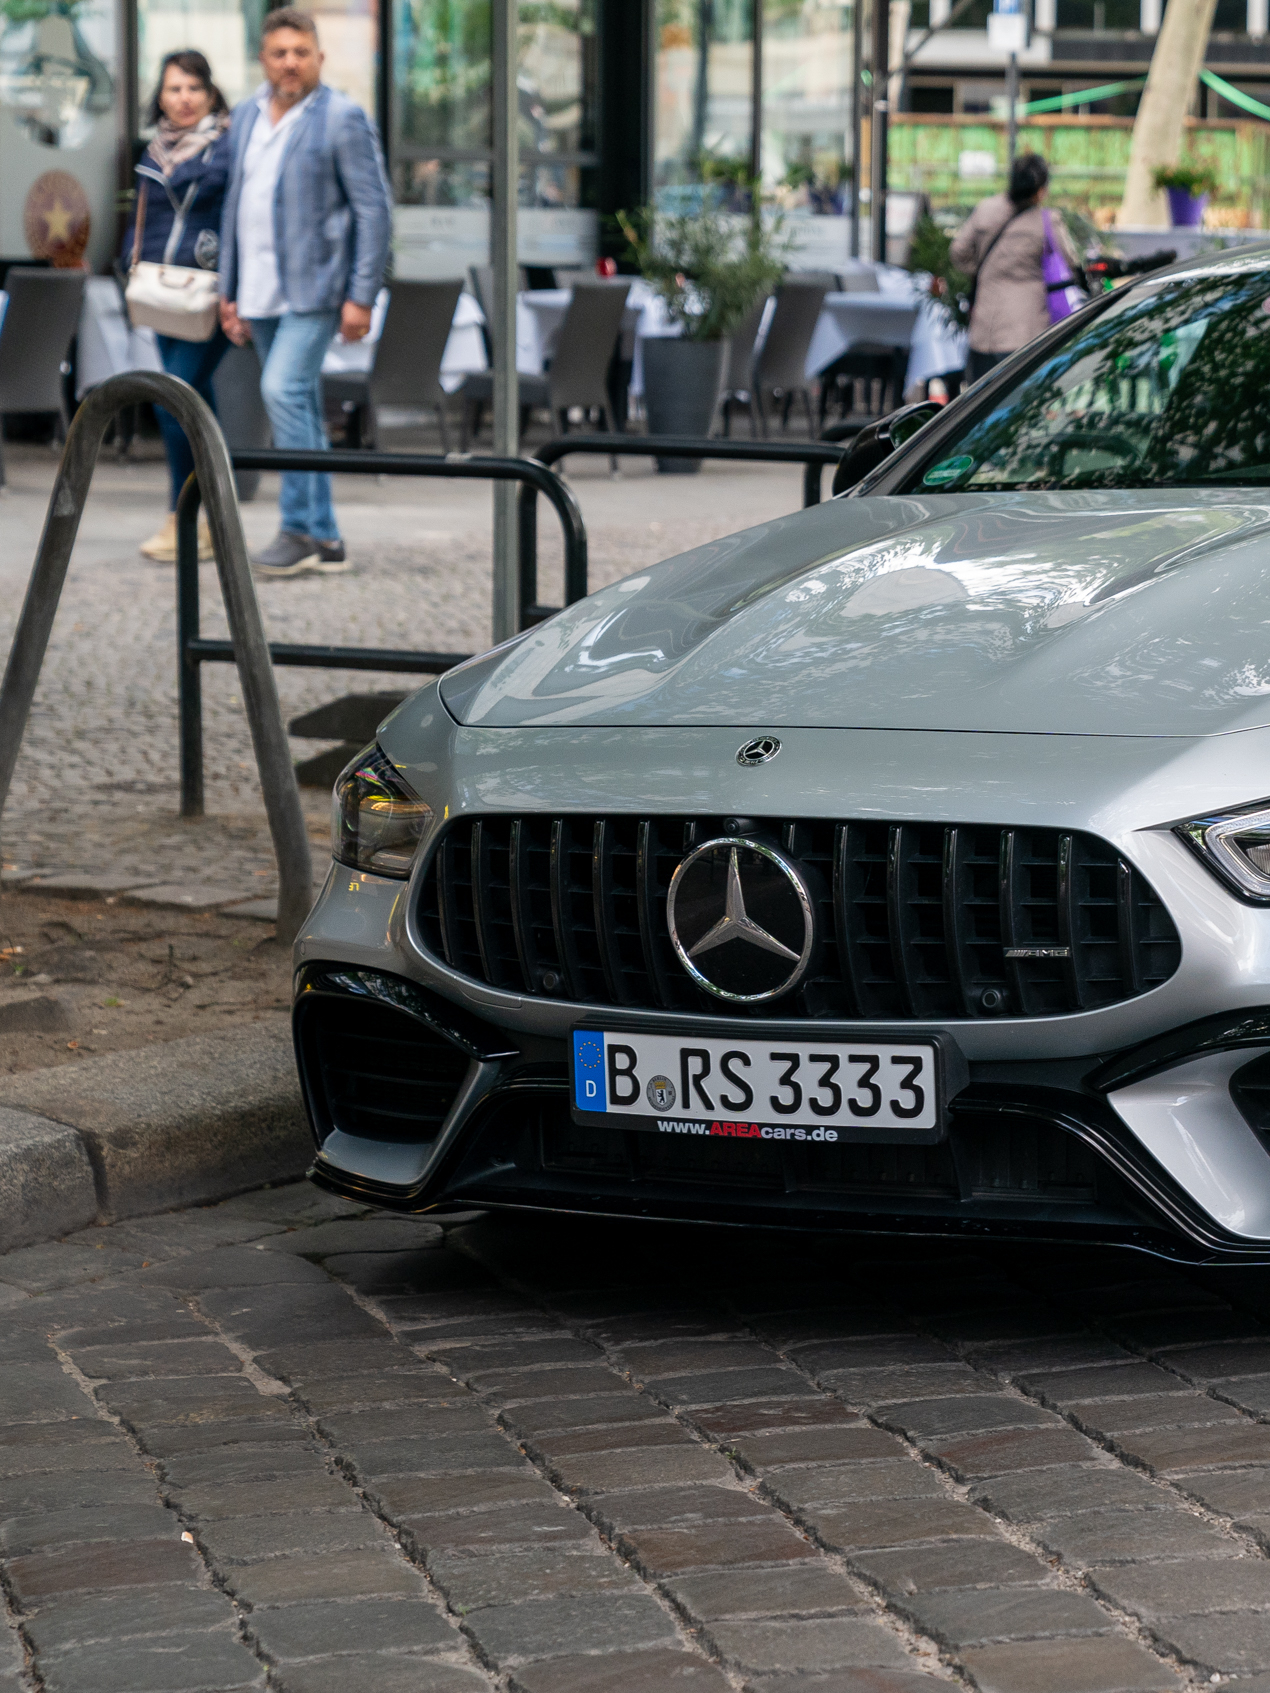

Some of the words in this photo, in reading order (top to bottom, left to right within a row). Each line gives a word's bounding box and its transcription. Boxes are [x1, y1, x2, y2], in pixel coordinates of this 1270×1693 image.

[586, 1079, 597, 1098] D
[607, 1043, 641, 1106] B
[679, 1047, 754, 1112] RS
[769, 1051, 925, 1119] 3333
[657, 1119, 839, 1142] www.AREAcars.de
